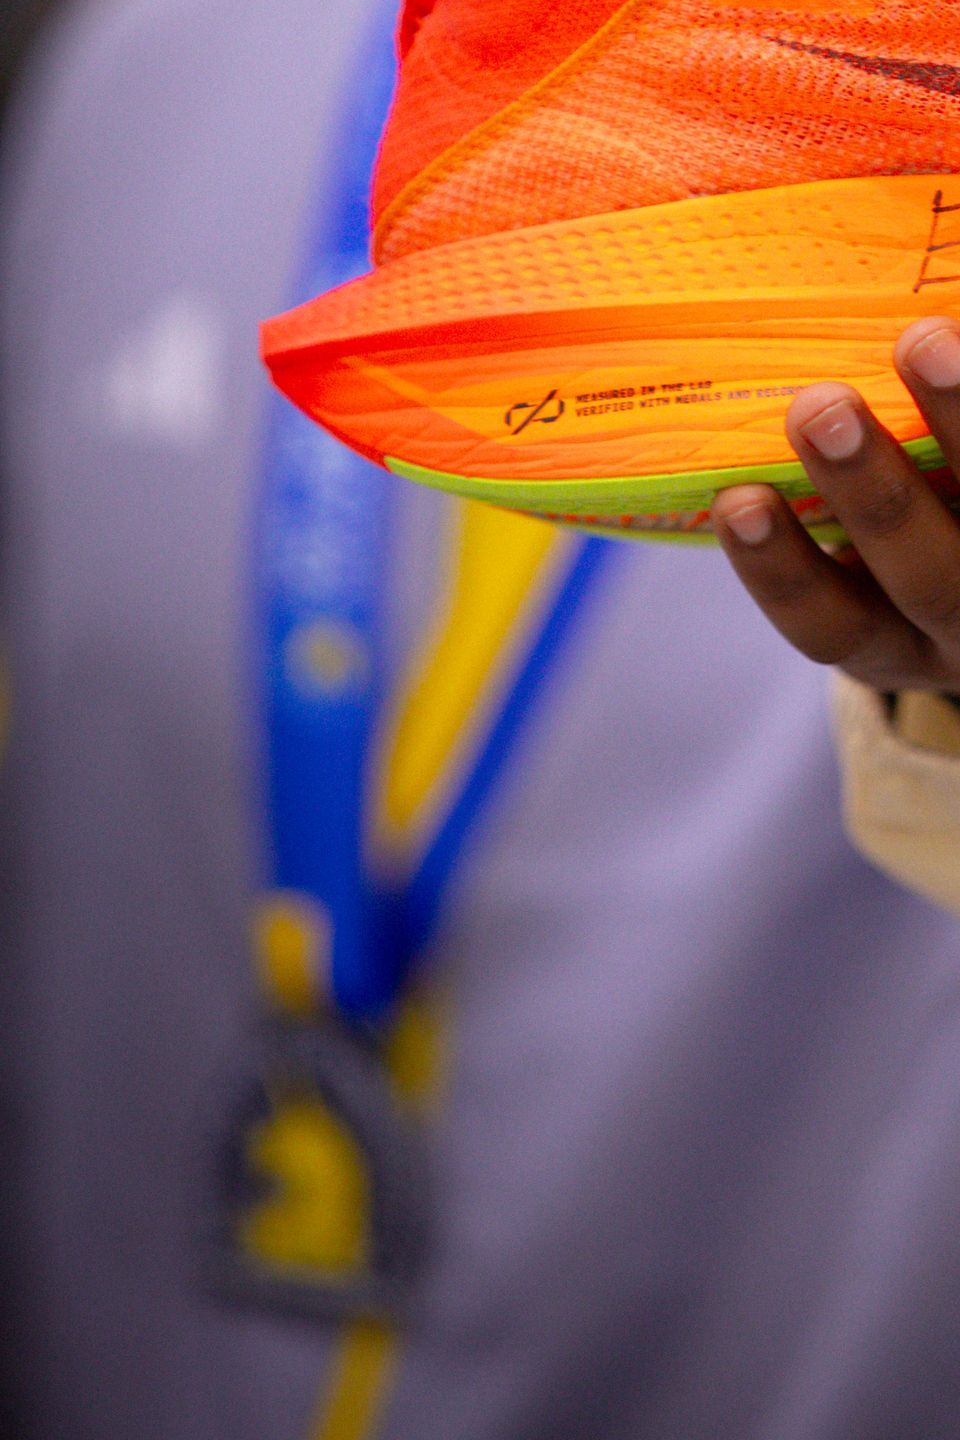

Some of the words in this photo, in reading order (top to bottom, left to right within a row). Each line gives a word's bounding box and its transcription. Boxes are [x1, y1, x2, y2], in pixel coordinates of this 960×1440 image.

[576, 388, 635, 402] MEASURED
[641, 385, 656, 395] IN
[661, 382, 685, 392] THE
[689, 380, 712, 390] LAB
[576, 401, 635, 416] VERIFIED
[640, 397, 670, 409] WITH
[675, 391, 723, 404] MEDALS
[728, 389, 751, 399] AND
